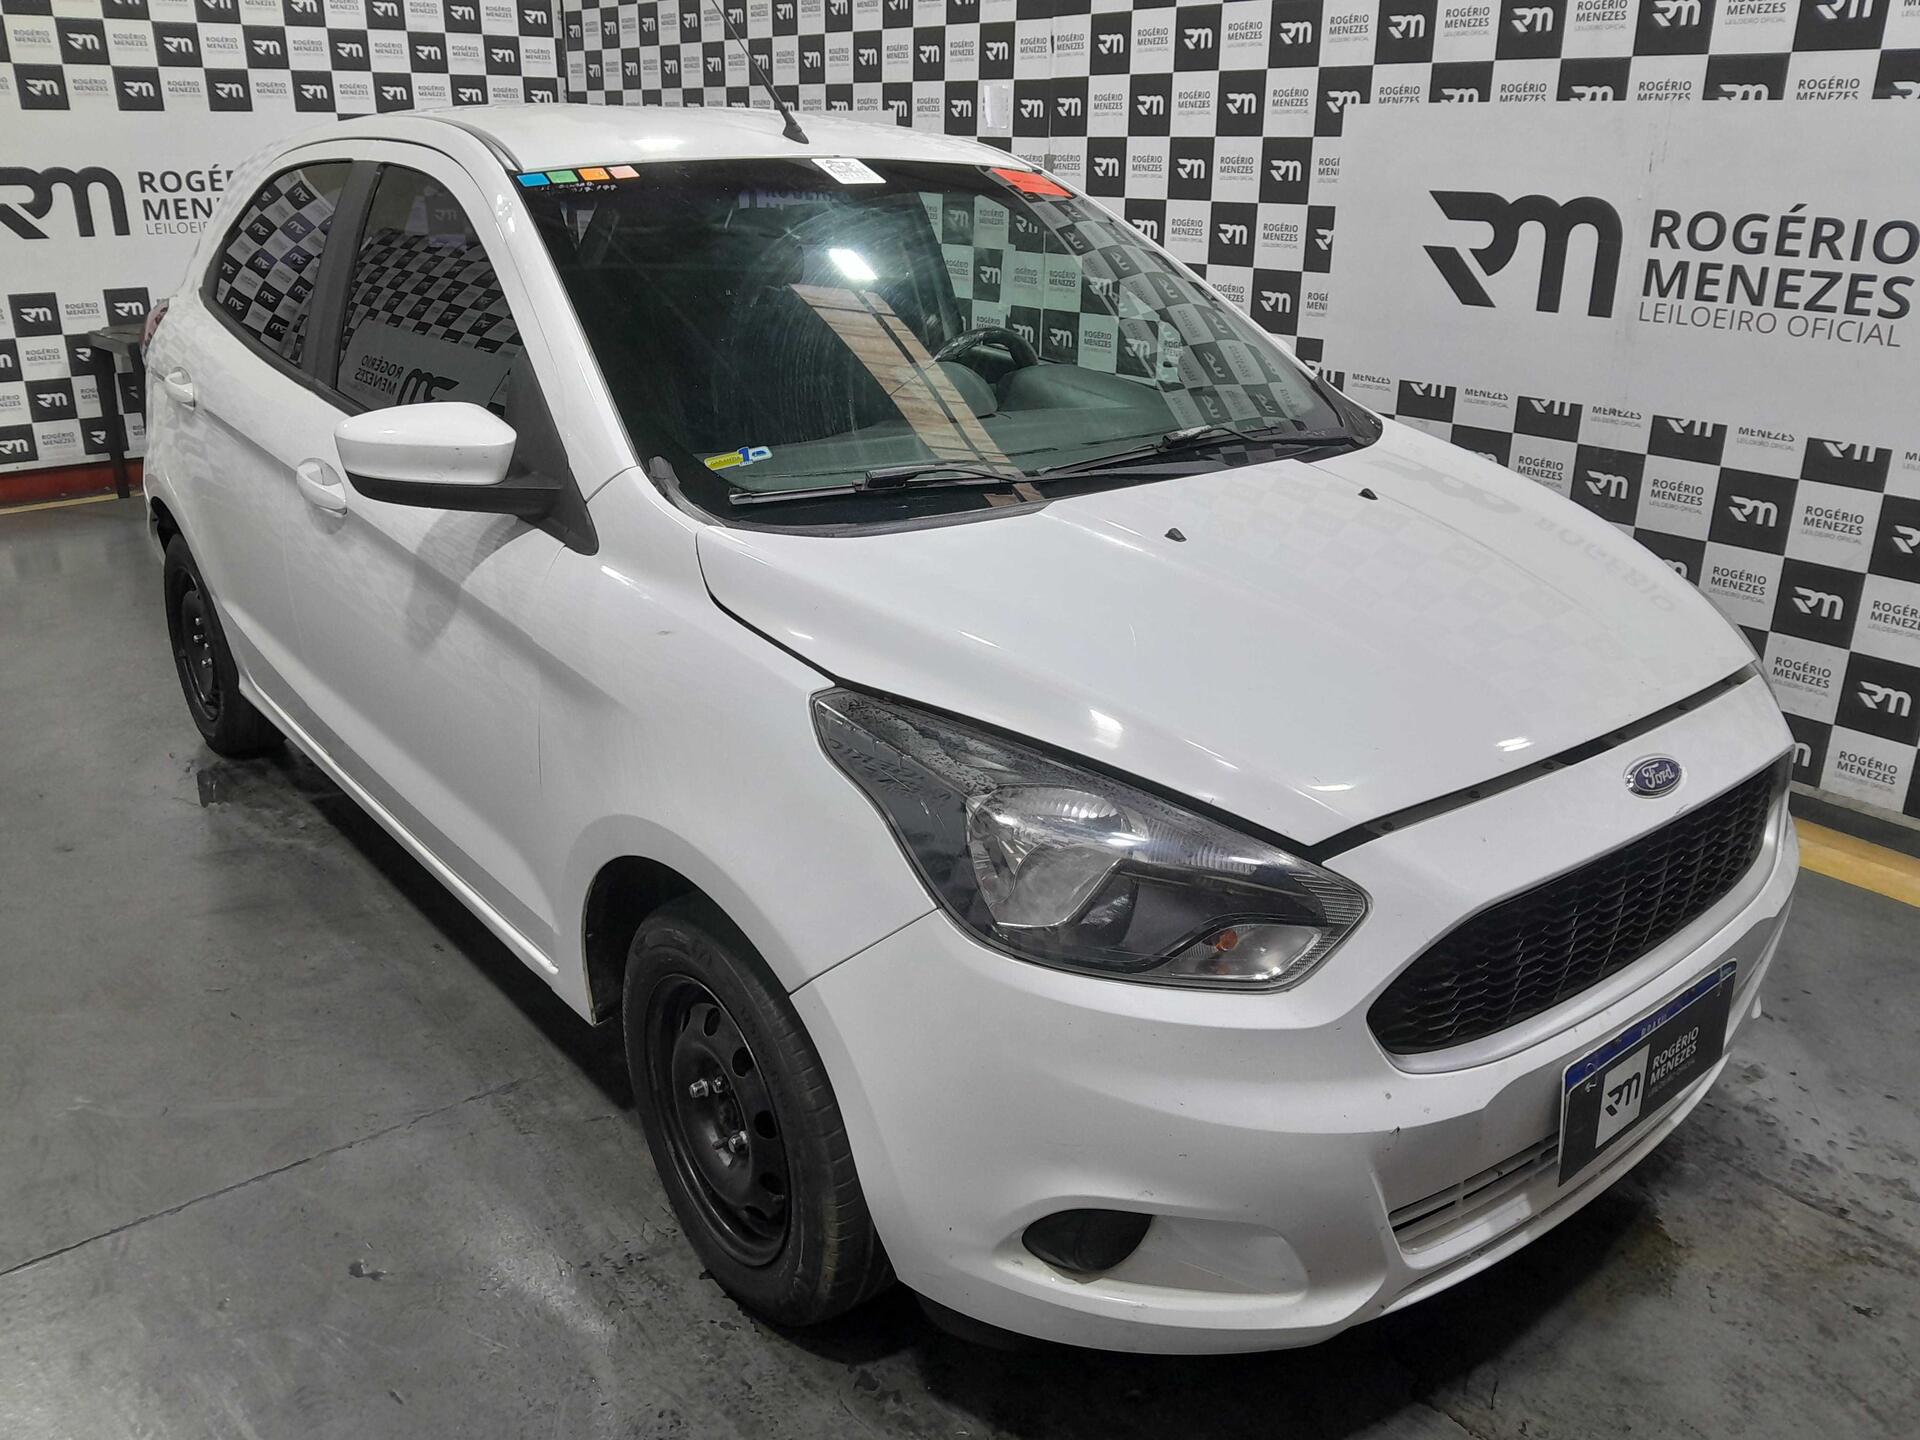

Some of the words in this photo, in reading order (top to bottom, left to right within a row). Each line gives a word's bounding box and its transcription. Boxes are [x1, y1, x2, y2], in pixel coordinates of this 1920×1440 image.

[1577, 0, 1628, 11] ROGÉRIO
[1726, 3, 1786, 15] MENEZES
[1445, 6, 1490, 18] ROGÉRIO
[1576, 10, 1627, 22] MENEZES
[1330, 13, 1369, 25] ROGÉRIO
[1444, 17, 1490, 29] MENEZES
[1137, 27, 1168, 37] ROGÉRIO
[1228, 21, 1263, 32] ROGÉRIO
[1329, 24, 1369, 35] MENEZES
[1020, 36, 1047, 46] ROGÉRIO
[1056, 33, 1084, 43] ROGÉRIO
[1137, 35, 1168, 46] MENEZES
[1227, 30, 1262, 41] MENEZES
[1020, 44, 1047, 54] MENEZES
[1056, 41, 1084, 51] MENEZES
[1501, 82, 1547, 94] ROGÉRIO
[1638, 78, 1692, 91] ROGÉRIO
[1797, 75, 1860, 90] ROGÉRIO
[1178, 89, 1211, 99] ROGÉRIO
[1272, 87, 1309, 98] ROGÉRIO
[1379, 84, 1420, 96] ROGÉRIO
[1094, 92, 1123, 102] ROGÉRIO
[1272, 97, 1308, 108] MENEZES
[1094, 101, 1123, 111] MENEZES
[1177, 98, 1210, 109] MENEZES
[1132, 154, 1162, 164] ROGÉRIO
[1220, 154, 1254, 165] ROGÉRIO
[1132, 163, 1162, 173] MENEZES
[1219, 163, 1253, 174] MENEZES
[138, 163, 234, 193] ROGÉ
[146, 221, 208, 235] LEILOEI
[1171, 218, 1203, 228] ROGÉRIO
[1263, 222, 1298, 233] ROGÉRIO
[1171, 227, 1203, 237] MENEZES
[1262, 231, 1298, 243] MENEZES
[1648, 203, 1920, 265] ROGÉRIO
[1642, 258, 1916, 320] MENEZES
[1638, 301, 1777, 335] LEILOEIRO
[1786, 315, 1901, 348] OFICIAL
[1518, 455, 1564, 471] ROGÉRIO
[1517, 465, 1563, 481] MENEZES
[1652, 478, 1704, 496] ROGÉRIO
[1650, 489, 1703, 506] MENEZES
[1805, 505, 1865, 525] ROGÉRIO
[1802, 516, 1863, 536] MENEZES
[1712, 566, 1767, 585] ROGÉRIO
[1710, 576, 1766, 596] MENEZES
[1872, 600, 1920, 619] ROGÉR
[1870, 611, 1920, 631] MENEZE
[1774, 656, 1832, 679] ROGÉRIO
[1772, 667, 1830, 689] MENEZES
[1838, 750, 1898, 775] ROGÉRIO
[1641, 763, 1675, 789] Ford
[1836, 761, 1896, 785] MENEZES
[1652, 1026, 1699, 1071] ROGÉRIO
[1650, 1041, 1697, 1086] MENEZES
